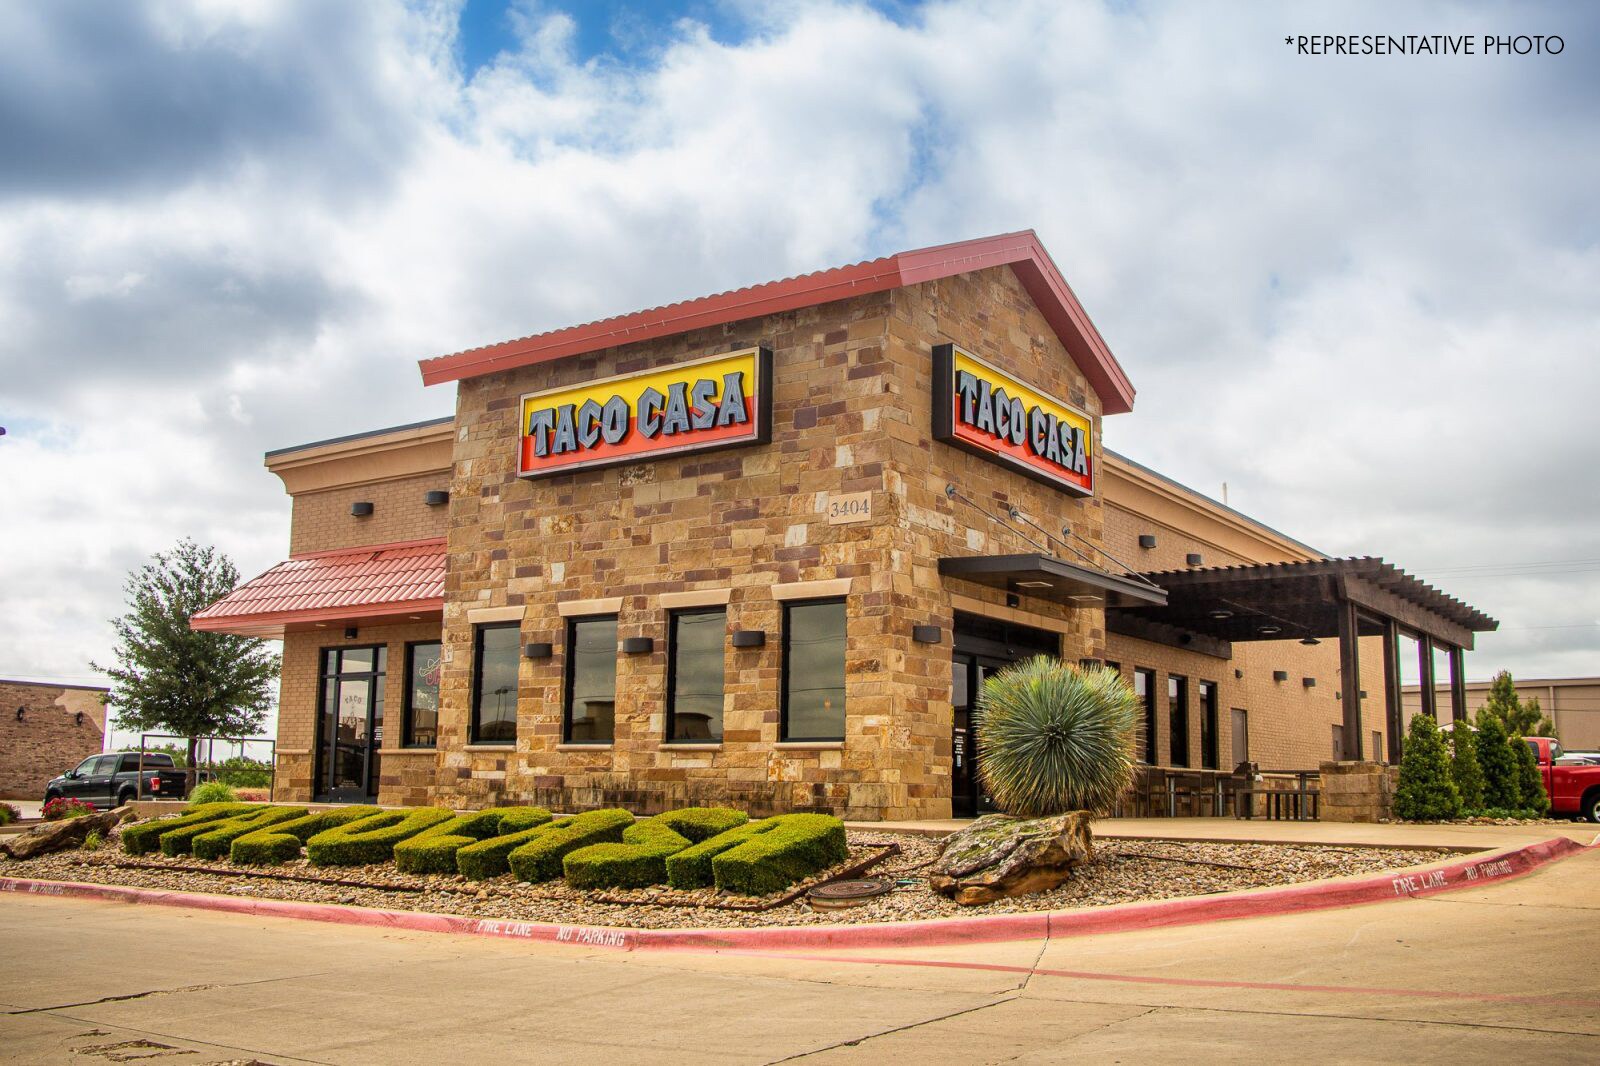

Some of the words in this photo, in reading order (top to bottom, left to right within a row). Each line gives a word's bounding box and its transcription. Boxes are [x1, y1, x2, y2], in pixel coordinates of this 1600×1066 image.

[528, 395, 630, 457] TACO
[637, 371, 747, 438] CASA
[956, 370, 1027, 446] TACO
[1028, 405, 1089, 476] CASA
[830, 498, 870, 518] 3404
[1392, 876, 1419, 895] FIRE
[1420, 870, 1448, 889] LANE
[1465, 866, 1478, 880] NO
[1479, 859, 1513, 878] PARKING
[477, 919, 500, 933] FIRE
[504, 921, 532, 937] LANE
[556, 926, 573, 941] NO
[576, 928, 625, 947] PARKING
